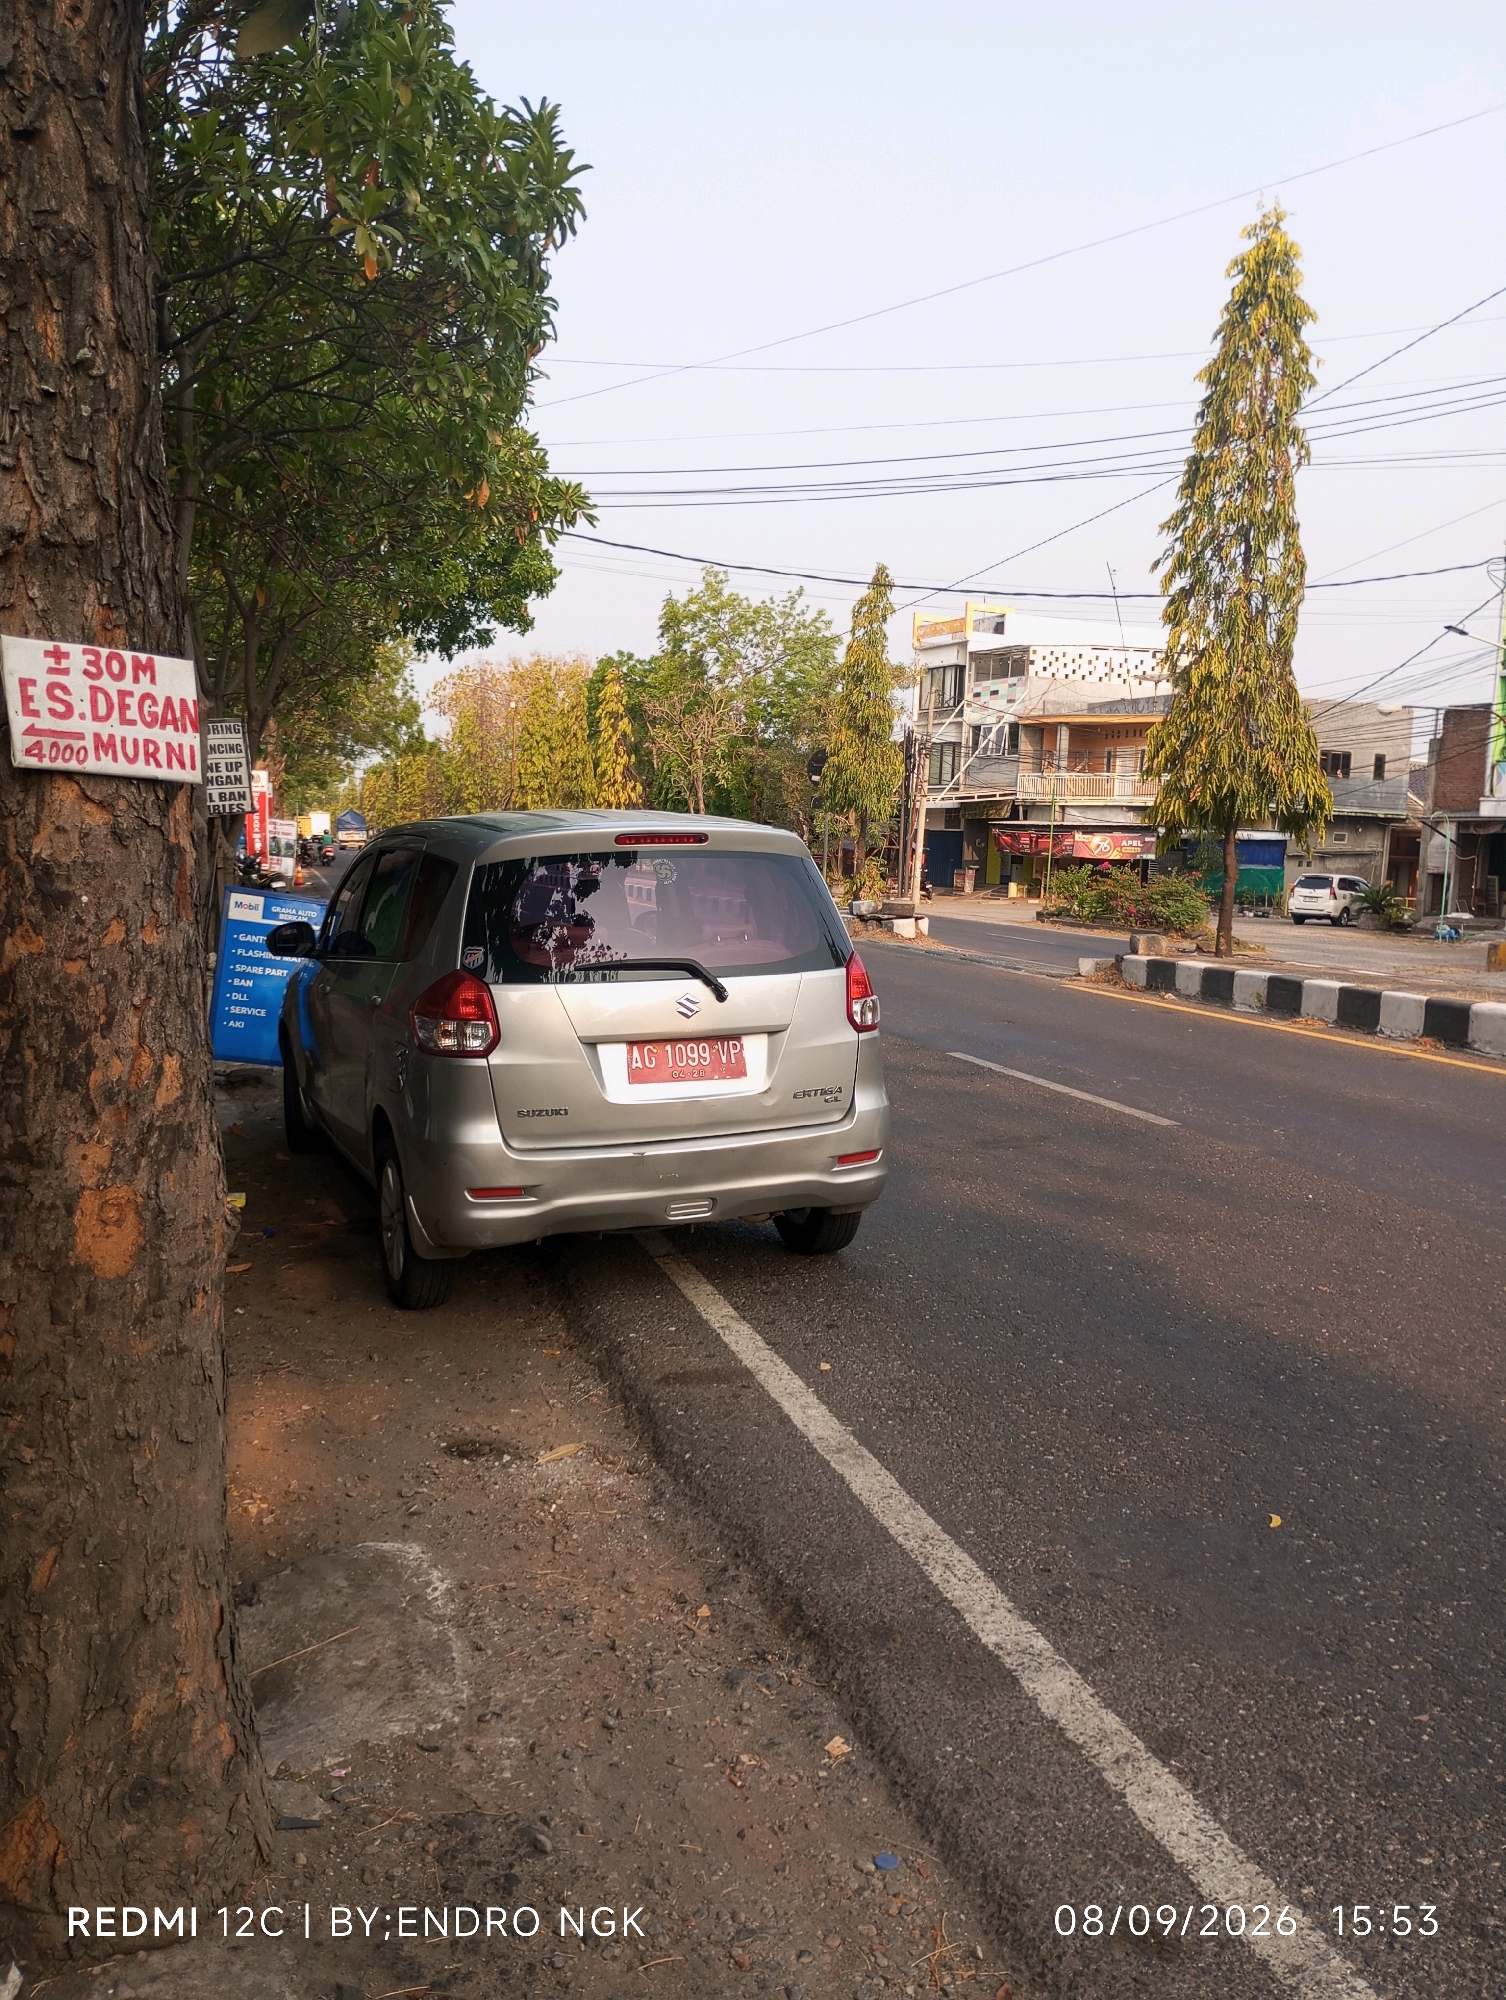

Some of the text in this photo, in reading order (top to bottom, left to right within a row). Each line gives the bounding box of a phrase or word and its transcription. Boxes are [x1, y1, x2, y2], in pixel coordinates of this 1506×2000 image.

[24, 732, 197, 771] 4000 MURNI
[208, 744, 242, 754] NCING
[226, 762, 242, 771] UP
[218, 790, 246, 802] BAN
[234, 900, 260, 911] Mobil
[272, 906, 296, 914] GRAHA
[234, 964, 264, 974] SPARE
[230, 1006, 266, 1016] SERVICE
[631, 1040, 740, 1070] AG 1099 VP
[793, 1085, 843, 1099] ERTIGA
[824, 1095, 842, 1103] GL
[516, 1107, 569, 1118] SUZUKI
